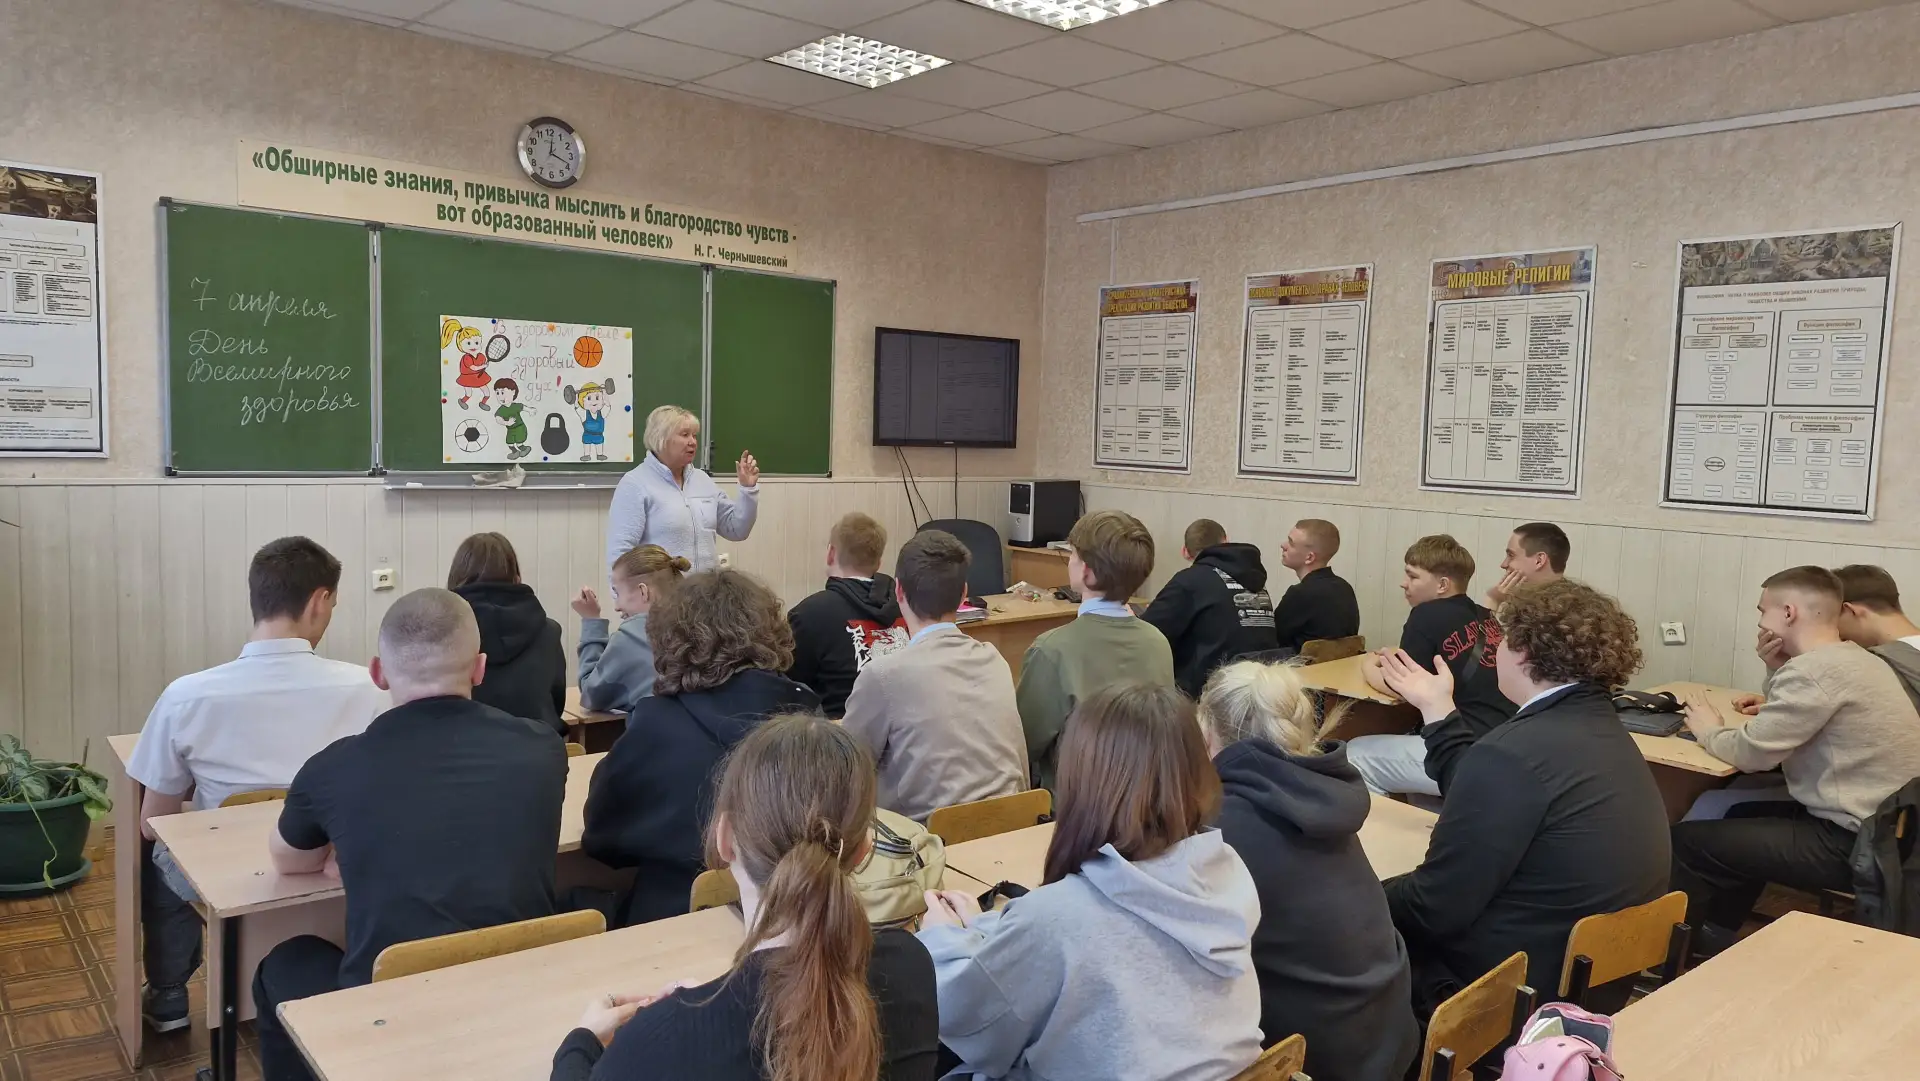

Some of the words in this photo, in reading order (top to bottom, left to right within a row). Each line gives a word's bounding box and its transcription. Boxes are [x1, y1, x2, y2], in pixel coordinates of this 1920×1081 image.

[536, 129, 543, 139] 11
[545, 128, 555, 137] 12
[558, 133, 563, 141] 1
[529, 137, 537, 146] 10
[564, 142, 571, 150] 2
[527, 147, 533, 155] 9
[568, 152, 574, 161] 3
[531, 158, 537, 167] 8
[564, 162, 571, 171] 4
[539, 166, 545, 175] 7
[548, 171, 555, 179] 6
[559, 169, 565, 177] 5
[252, 146, 378, 185] «Обширные
[384, 169, 459, 202] знания,
[464, 181, 550, 210] привычка
[555, 195, 627, 221] мыслить
[631, 206, 640, 223] и
[644, 204, 743, 237] благородство
[746, 223, 789, 245] чувств
[436, 203, 467, 223] вот
[471, 204, 597, 241] образованный
[601, 226, 674, 250] человек»
[694, 243, 704, 257] Н.
[707, 245, 716, 258] Г.
[718, 247, 788, 268] Чернышевский
[1448, 269, 1509, 289] МИРОВЫЕ
[1514, 264, 1572, 284] РЕЛИГИИ
[190, 276, 218, 311] 7
[228, 290, 338, 327] апреля
[188, 328, 269, 356] День
[511, 345, 575, 380] здоровый
[187, 355, 351, 394] Всемирного
[240, 385, 360, 426] здоровья
